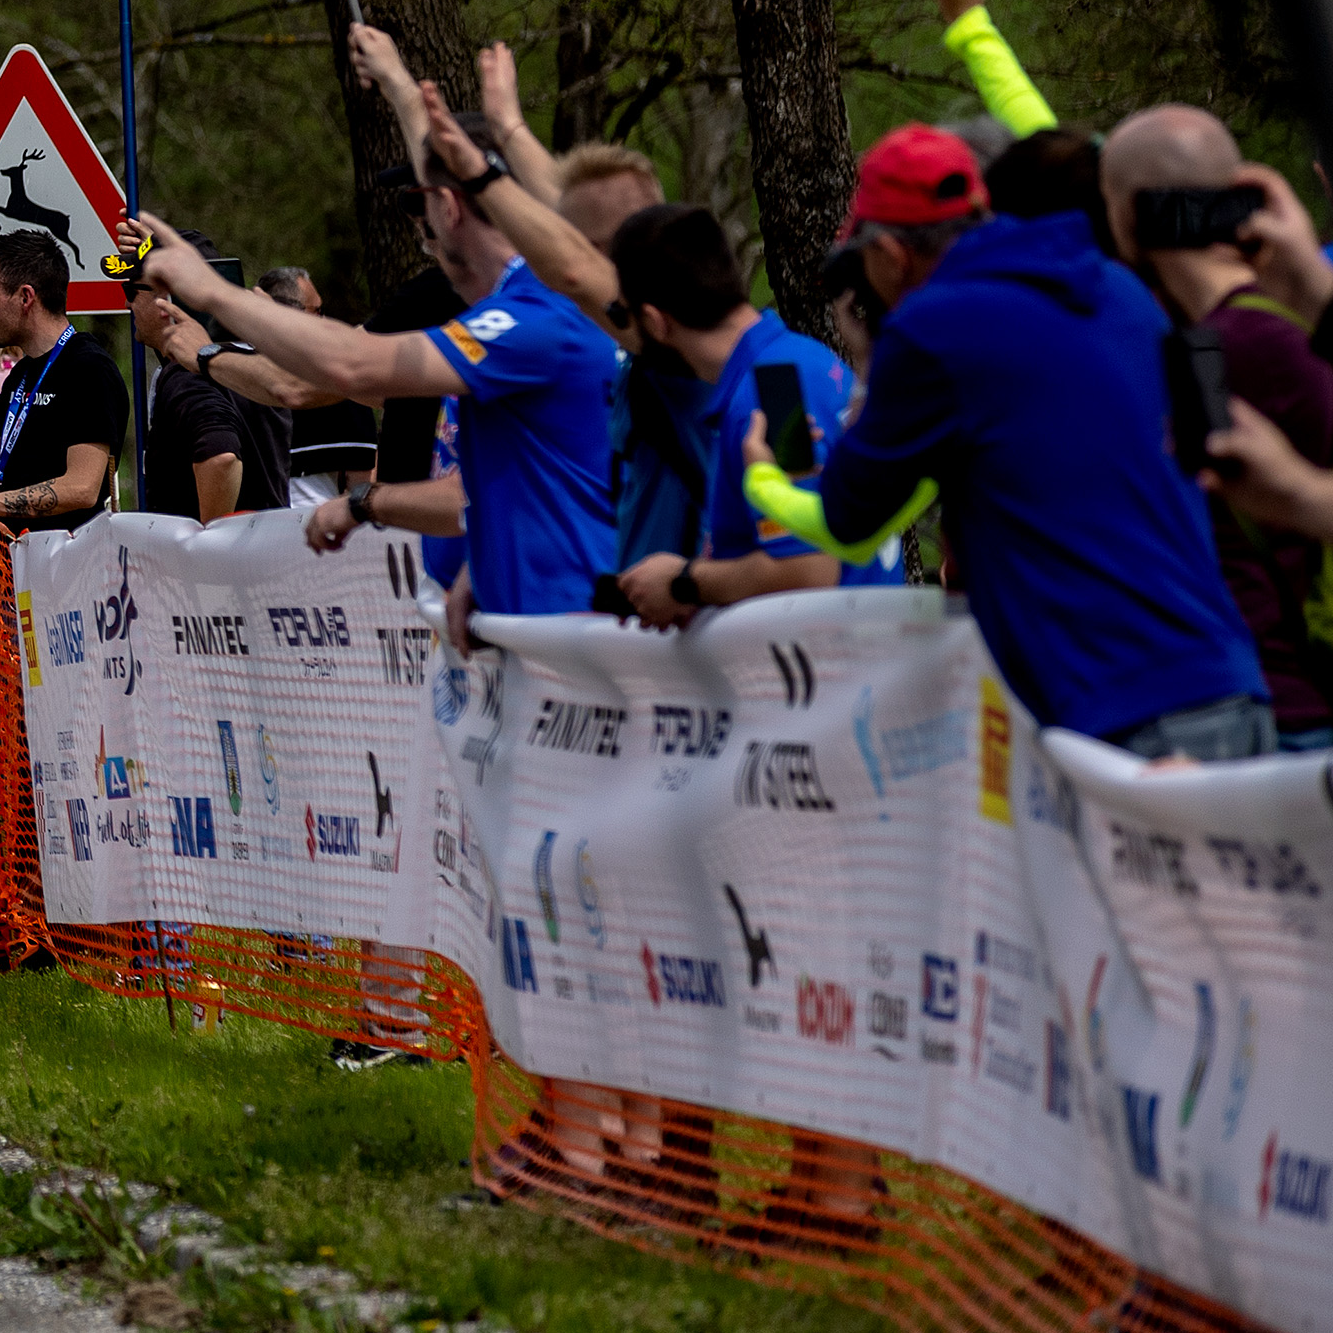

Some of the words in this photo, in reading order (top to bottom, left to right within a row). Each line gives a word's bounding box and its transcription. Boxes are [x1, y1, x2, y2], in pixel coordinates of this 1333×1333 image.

[172, 616, 250, 656] FANATEC
[168, 796, 218, 859] INA
[318, 814, 361, 856] SUZUKI
